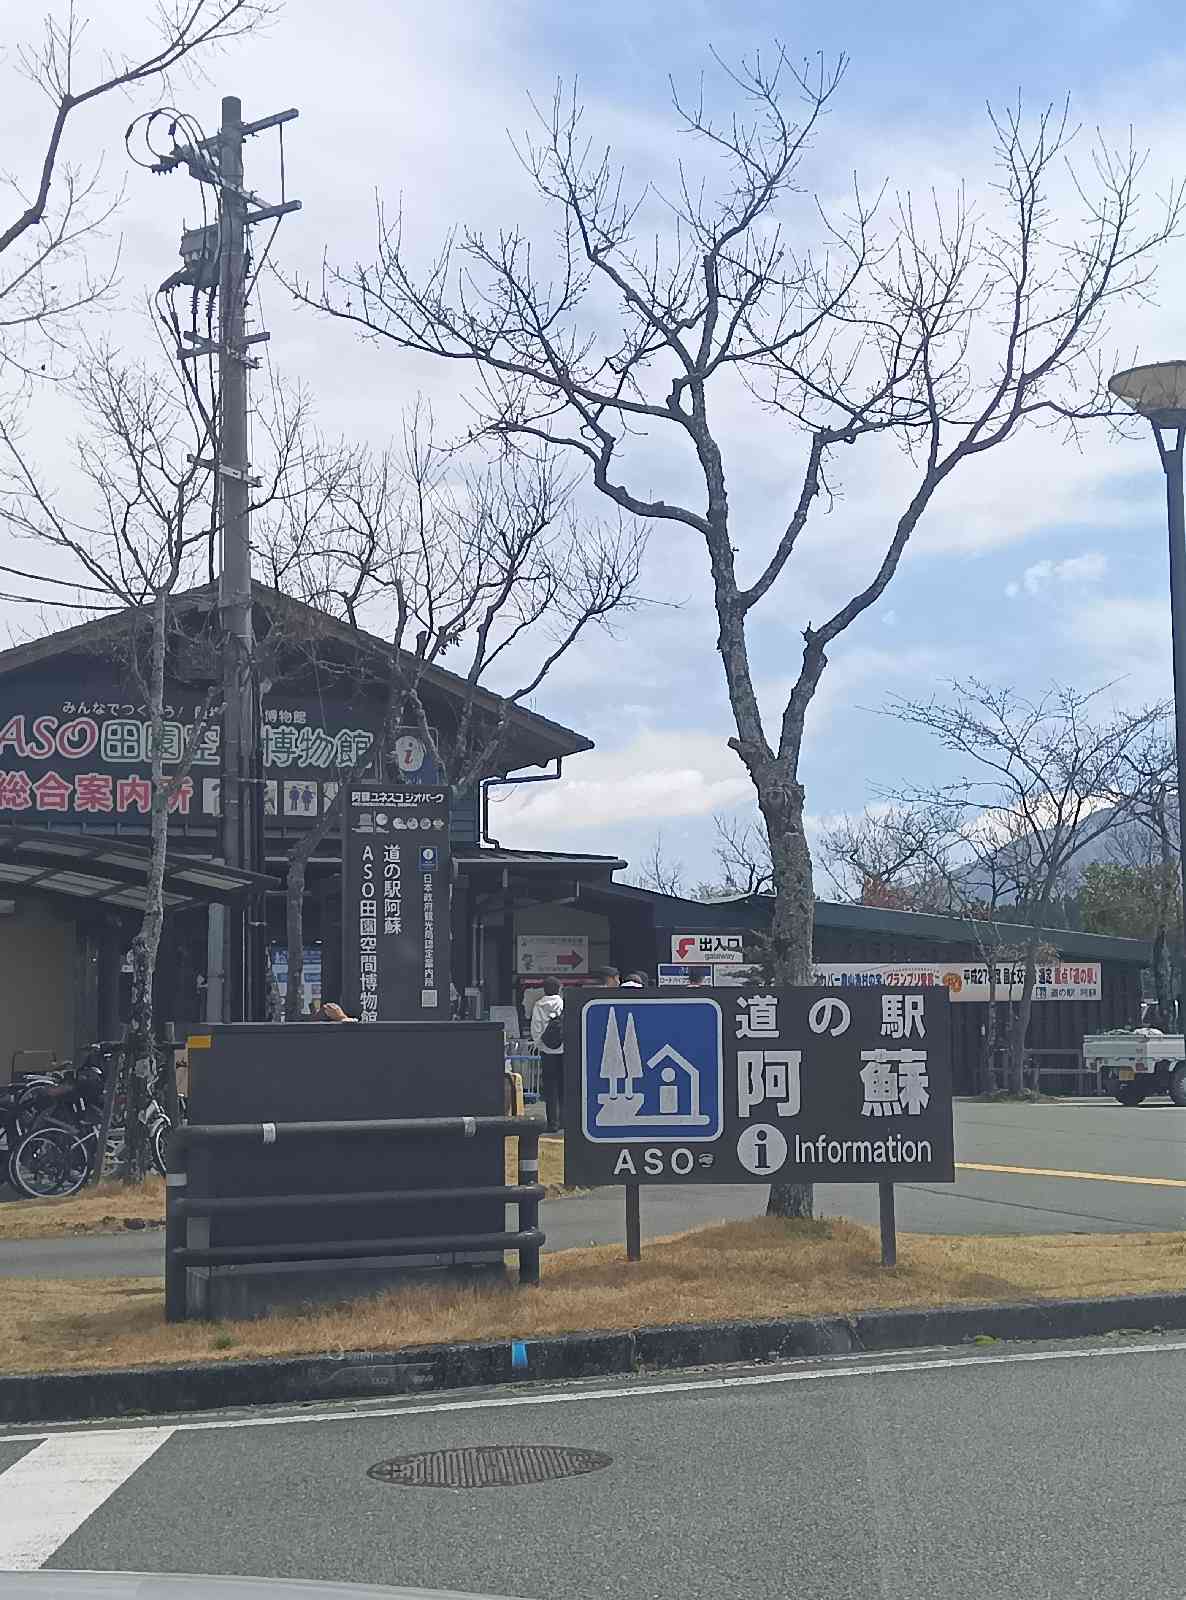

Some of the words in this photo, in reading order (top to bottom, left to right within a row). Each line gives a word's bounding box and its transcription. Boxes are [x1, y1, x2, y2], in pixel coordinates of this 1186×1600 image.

[62, 701, 185, 718] みんなでつくう！
[384, 844, 402, 934] 道の駅阿蘇
[700, 937, 742, 952] 出入口
[735, 995, 926, 1040] 道の駅
[737, 1048, 931, 1118] 阿蘇
[613, 1148, 695, 1176] ASO
[794, 1133, 932, 1164] Information
